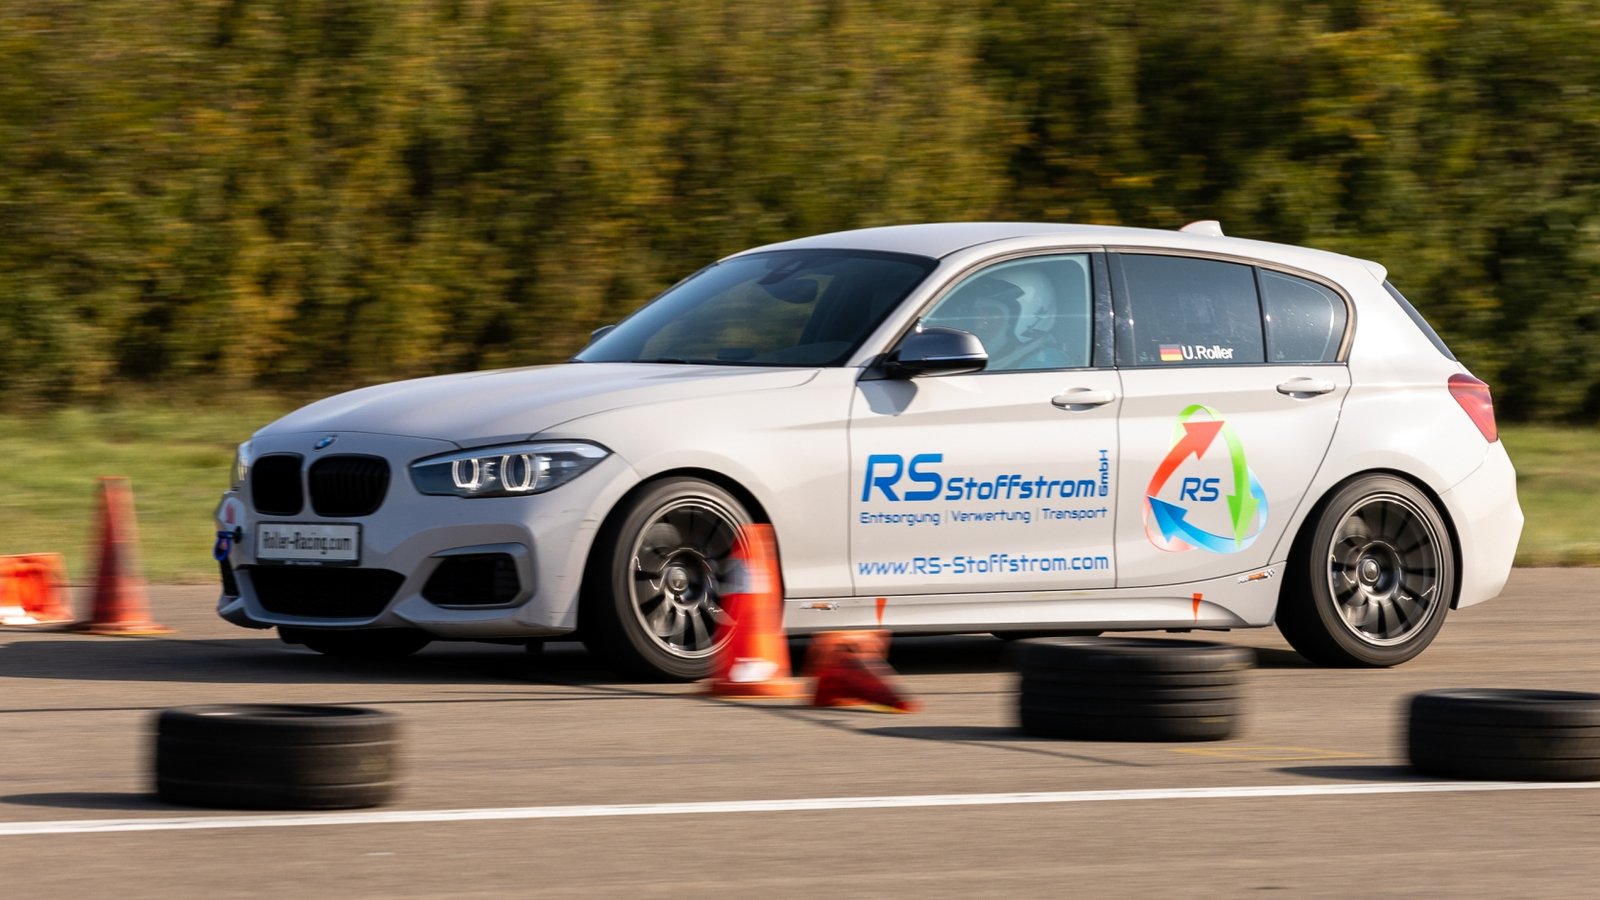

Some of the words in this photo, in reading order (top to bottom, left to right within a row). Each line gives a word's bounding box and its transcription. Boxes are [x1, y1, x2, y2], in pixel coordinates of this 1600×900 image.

[1181, 345, 1234, 360] U.Roller
[861, 453, 944, 503] RS
[945, 474, 1097, 501] Stoffstrom
[1098, 449, 1109, 497] GmbH
[1179, 477, 1221, 502] RS
[859, 511, 941, 527] Entsorgung
[951, 509, 1031, 524] Verwertung
[1042, 506, 1108, 521] Transport
[858, 553, 1110, 576] www.RS-Stoffstrom.com
